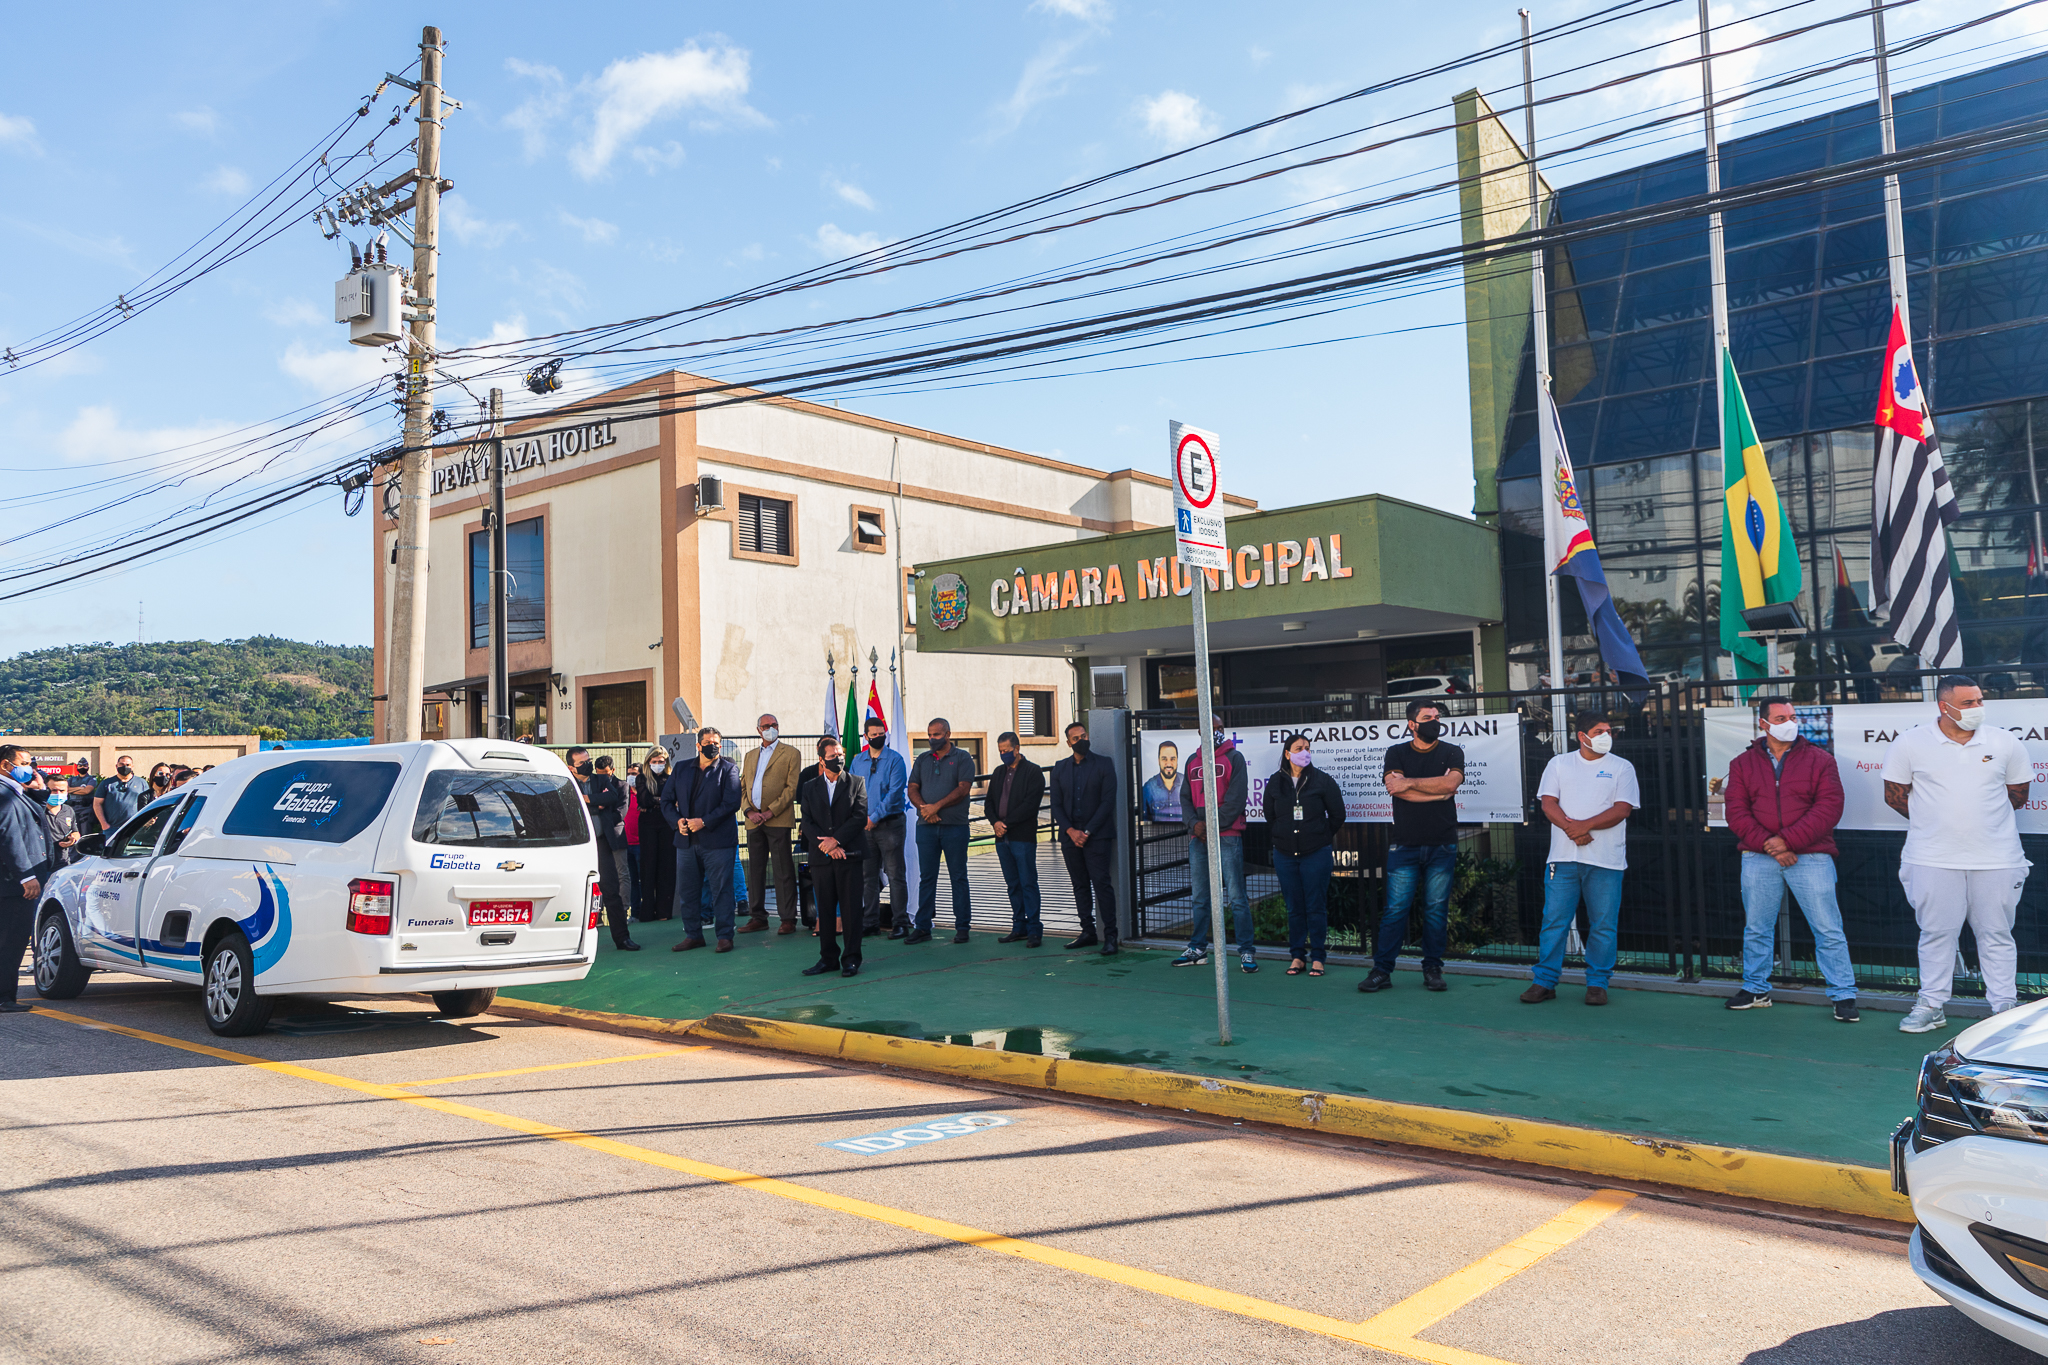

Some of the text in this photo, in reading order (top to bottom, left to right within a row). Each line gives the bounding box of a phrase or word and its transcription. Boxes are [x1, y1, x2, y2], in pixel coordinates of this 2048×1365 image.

[431, 418, 616, 496] PEVA PAZA HOTEL
[1190, 451, 1204, 492] E
[1193, 515, 1222, 528] EXCLUSIVO
[1198, 527, 1219, 537] IDOSOS
[990, 566, 1126, 618] CÂMARA
[560, 701, 572, 711] 895
[1386, 719, 1498, 740] CADIANI
[1333, 754, 1362, 762] vereador
[1335, 747, 1353, 755] pesar
[1353, 747, 1366, 755] que
[273, 783, 337, 814] Gabetta
[282, 815, 307, 824] Funerais
[430, 854, 481, 871] Gabetta
[408, 917, 455, 926] Funerais
[834, 1115, 1009, 1153] IDOSO
